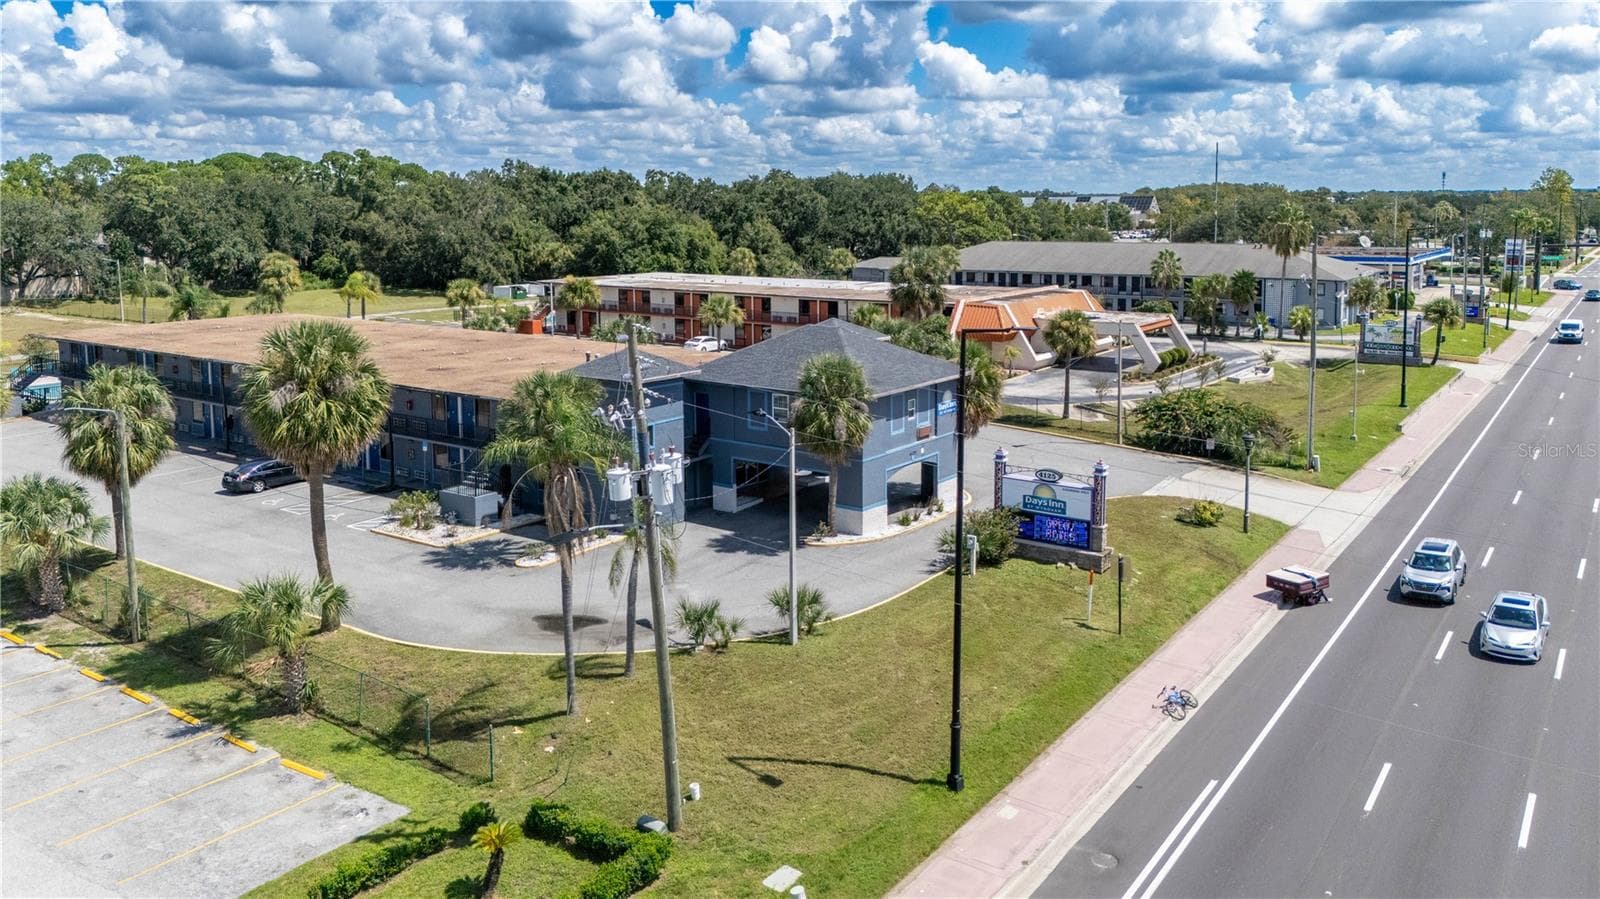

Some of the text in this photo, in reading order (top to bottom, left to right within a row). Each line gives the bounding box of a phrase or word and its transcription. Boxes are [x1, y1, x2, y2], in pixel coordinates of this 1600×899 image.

[1038, 471, 1057, 480] 4125
[1025, 496, 1064, 509] Days Inn
